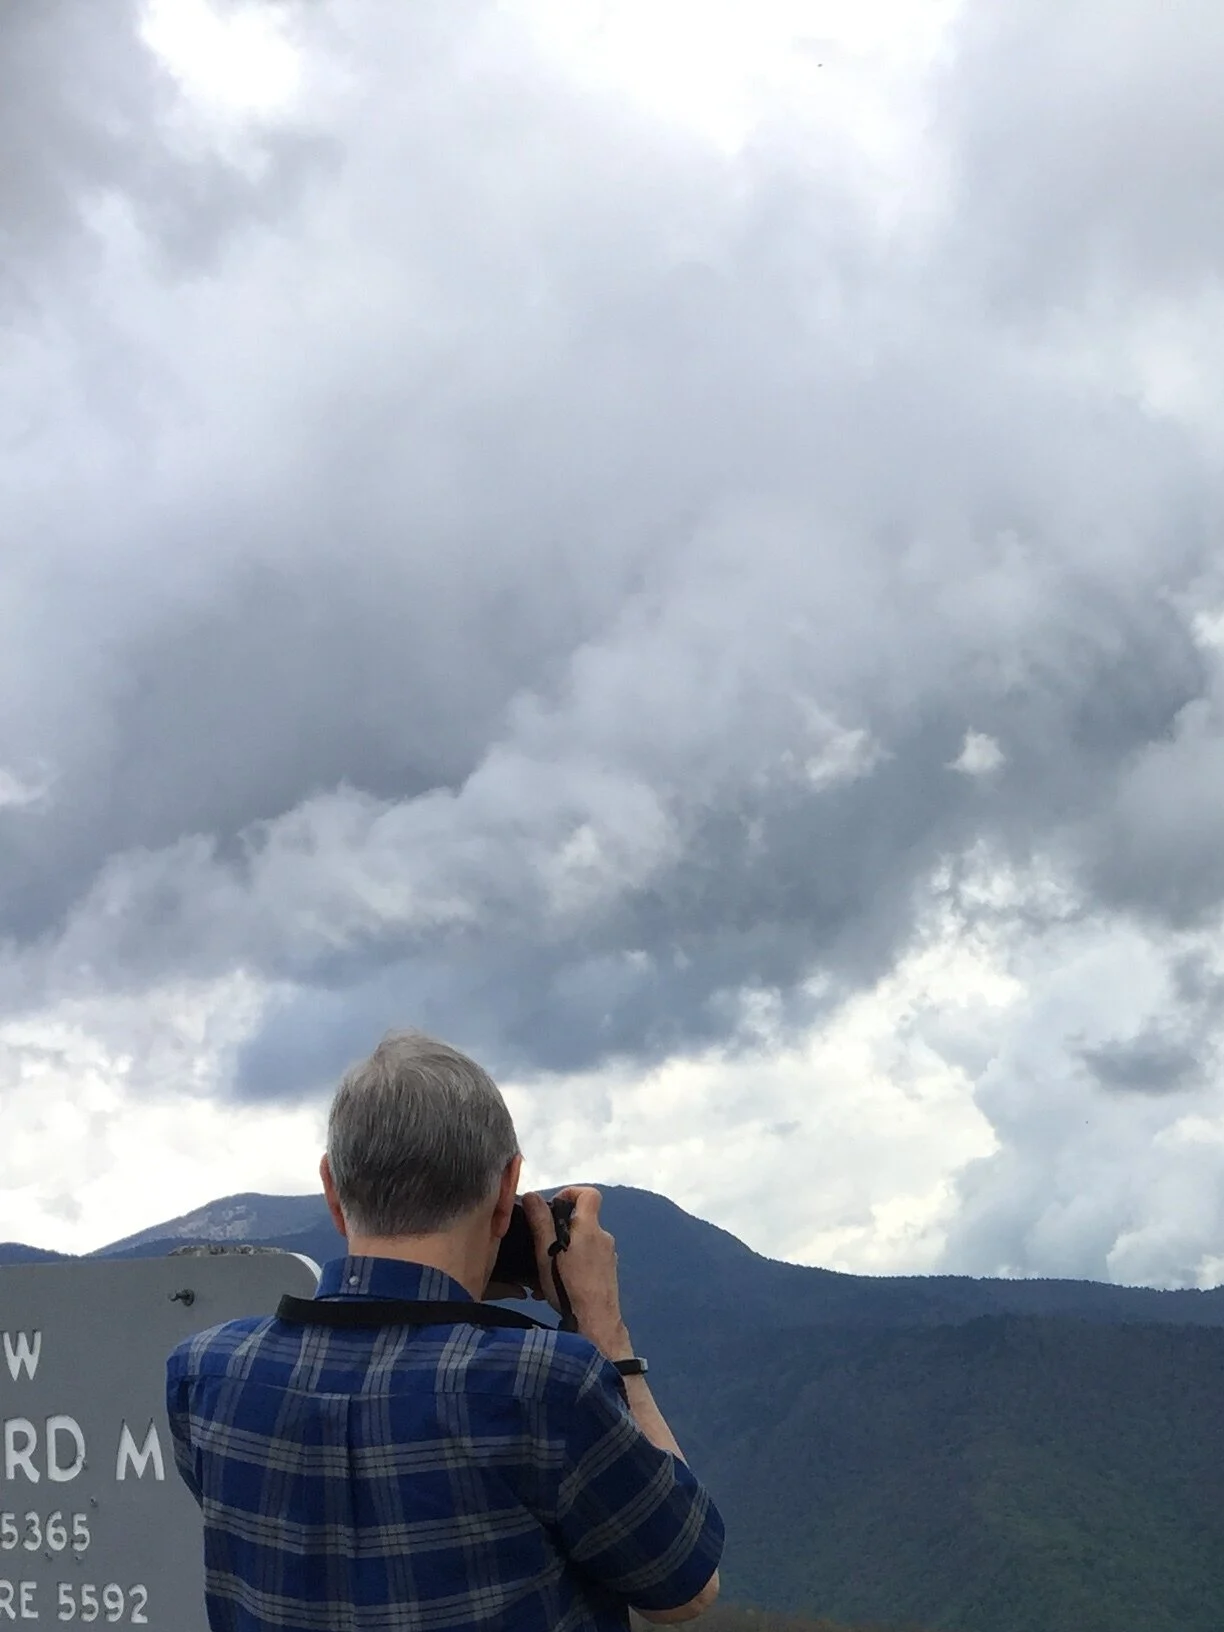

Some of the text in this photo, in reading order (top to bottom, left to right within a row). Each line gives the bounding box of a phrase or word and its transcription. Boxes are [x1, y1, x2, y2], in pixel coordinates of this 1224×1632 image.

[2, 1331, 42, 1382] W
[4, 1415, 165, 1484] RD M
[0, 1510, 91, 1552] 5365
[0, 1579, 149, 1624] RE 5592
